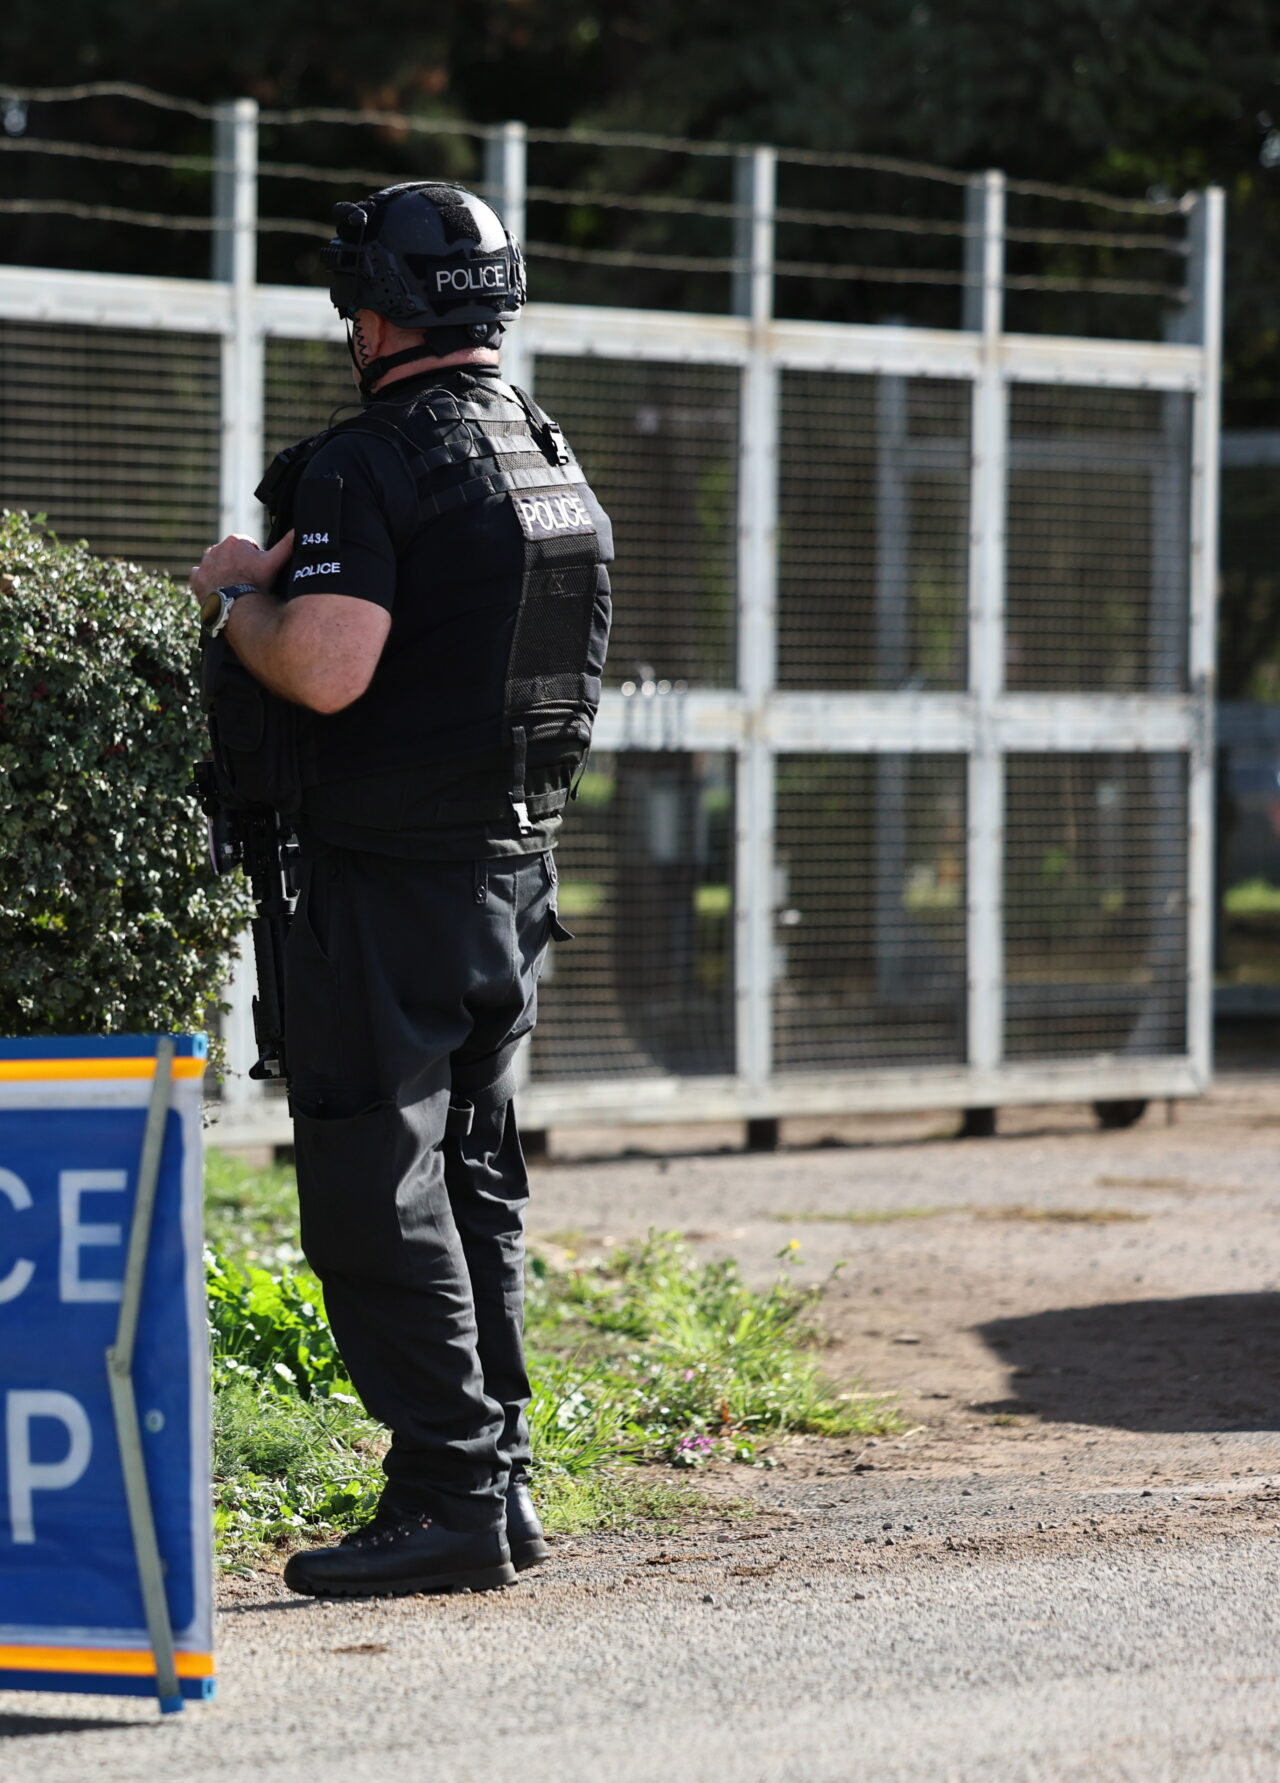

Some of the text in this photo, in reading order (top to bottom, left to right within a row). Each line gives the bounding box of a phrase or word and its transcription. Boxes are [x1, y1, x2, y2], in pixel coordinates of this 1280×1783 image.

[435, 265, 505, 293] POLICE
[519, 497, 593, 533] POLICE
[301, 532, 330, 546] 2434
[293, 562, 341, 582] POLICE
